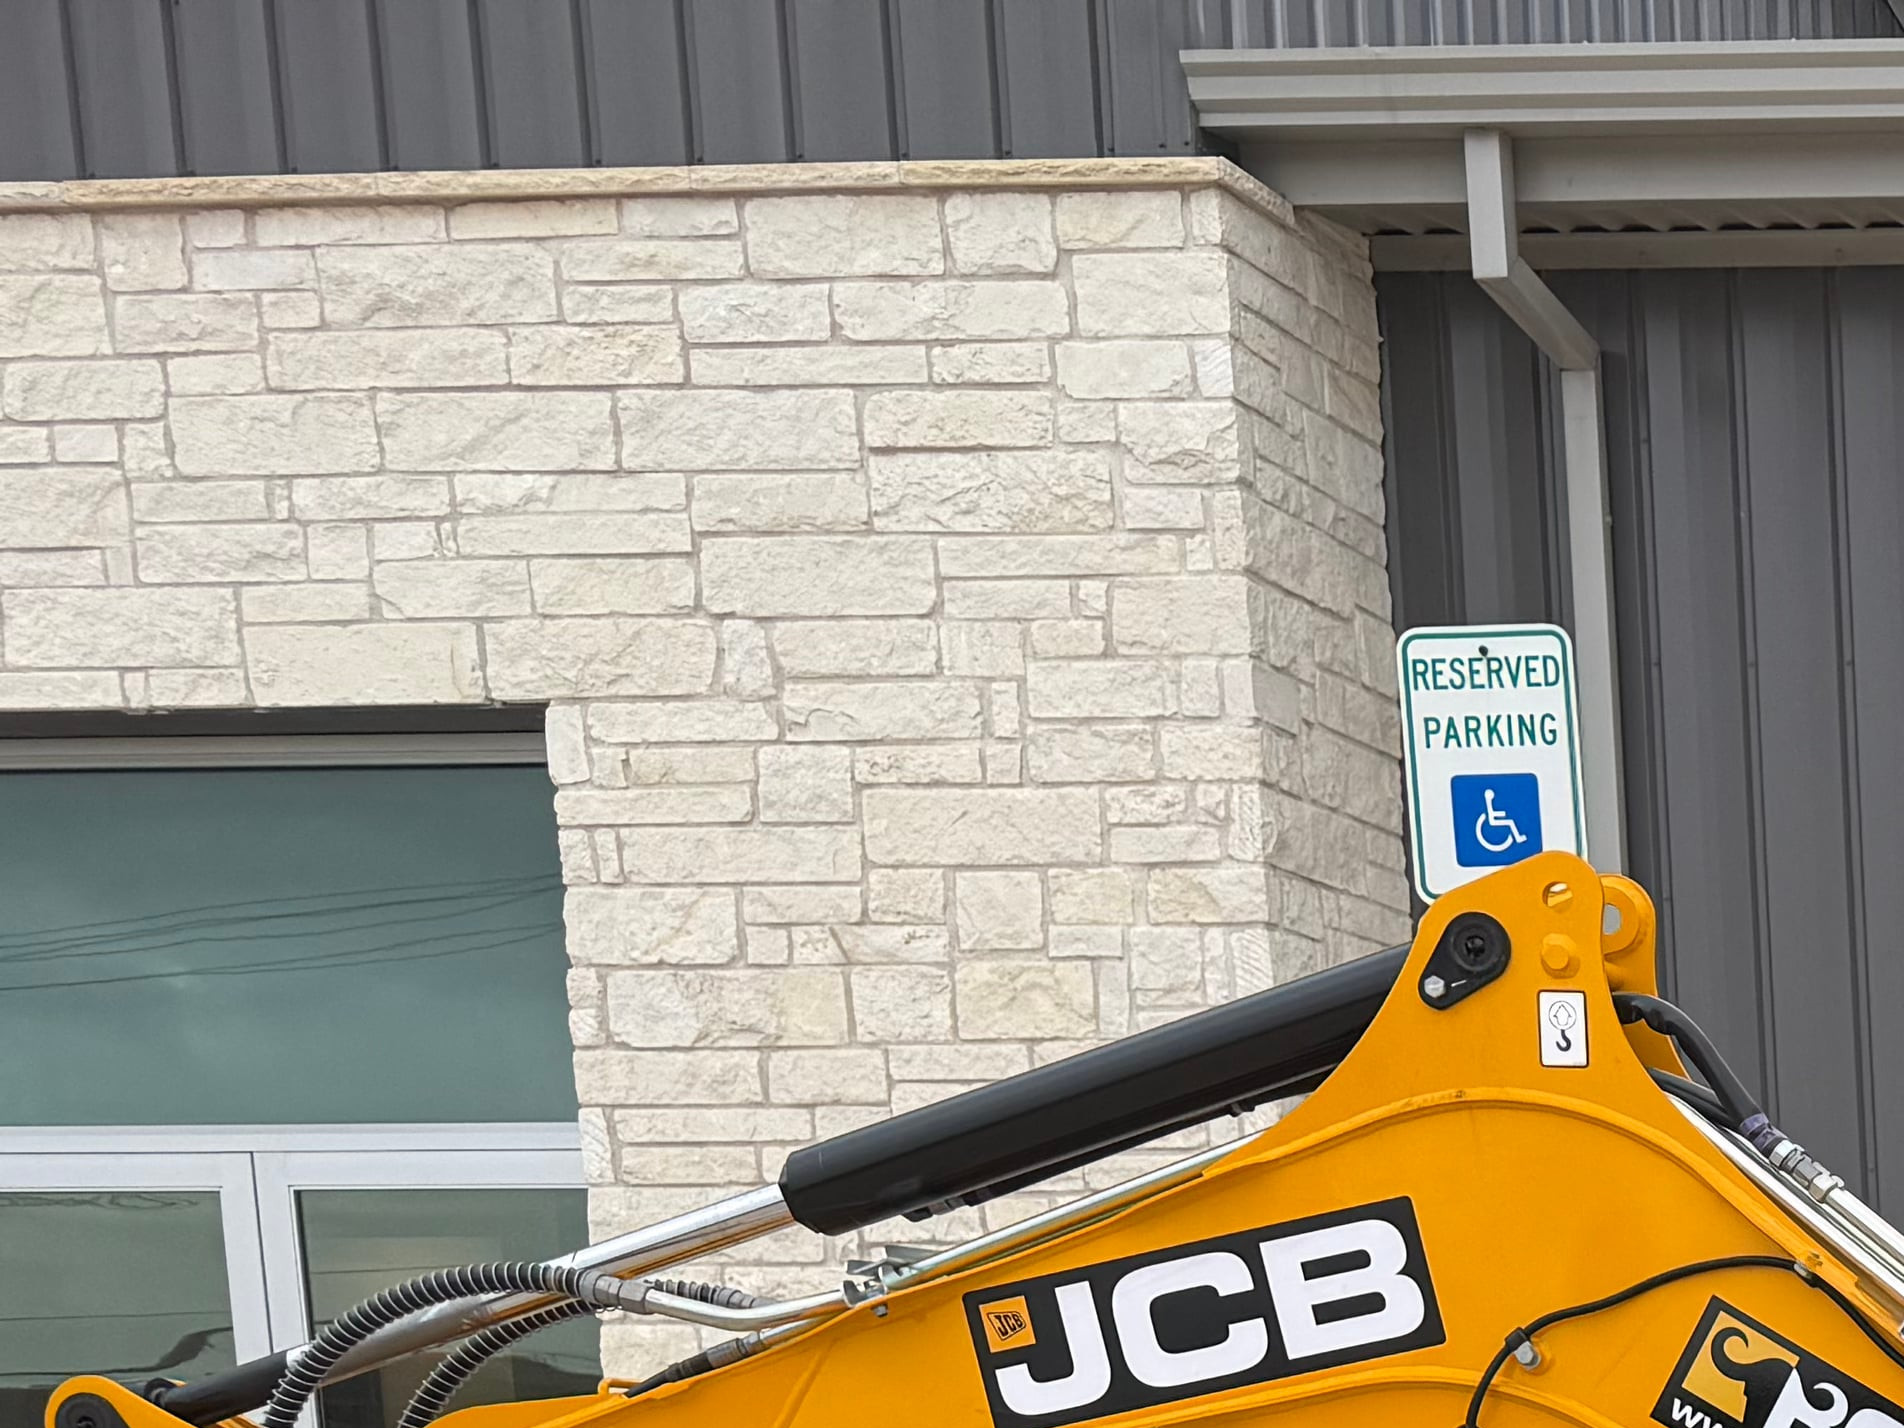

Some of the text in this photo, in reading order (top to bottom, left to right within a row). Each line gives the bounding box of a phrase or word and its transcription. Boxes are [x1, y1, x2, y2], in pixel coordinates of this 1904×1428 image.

[1411, 655, 1560, 691] RESERVED
[1423, 713, 1558, 749] PARKING
[994, 1314, 1023, 1337] JCB
[995, 1219, 1425, 1416] JCB
